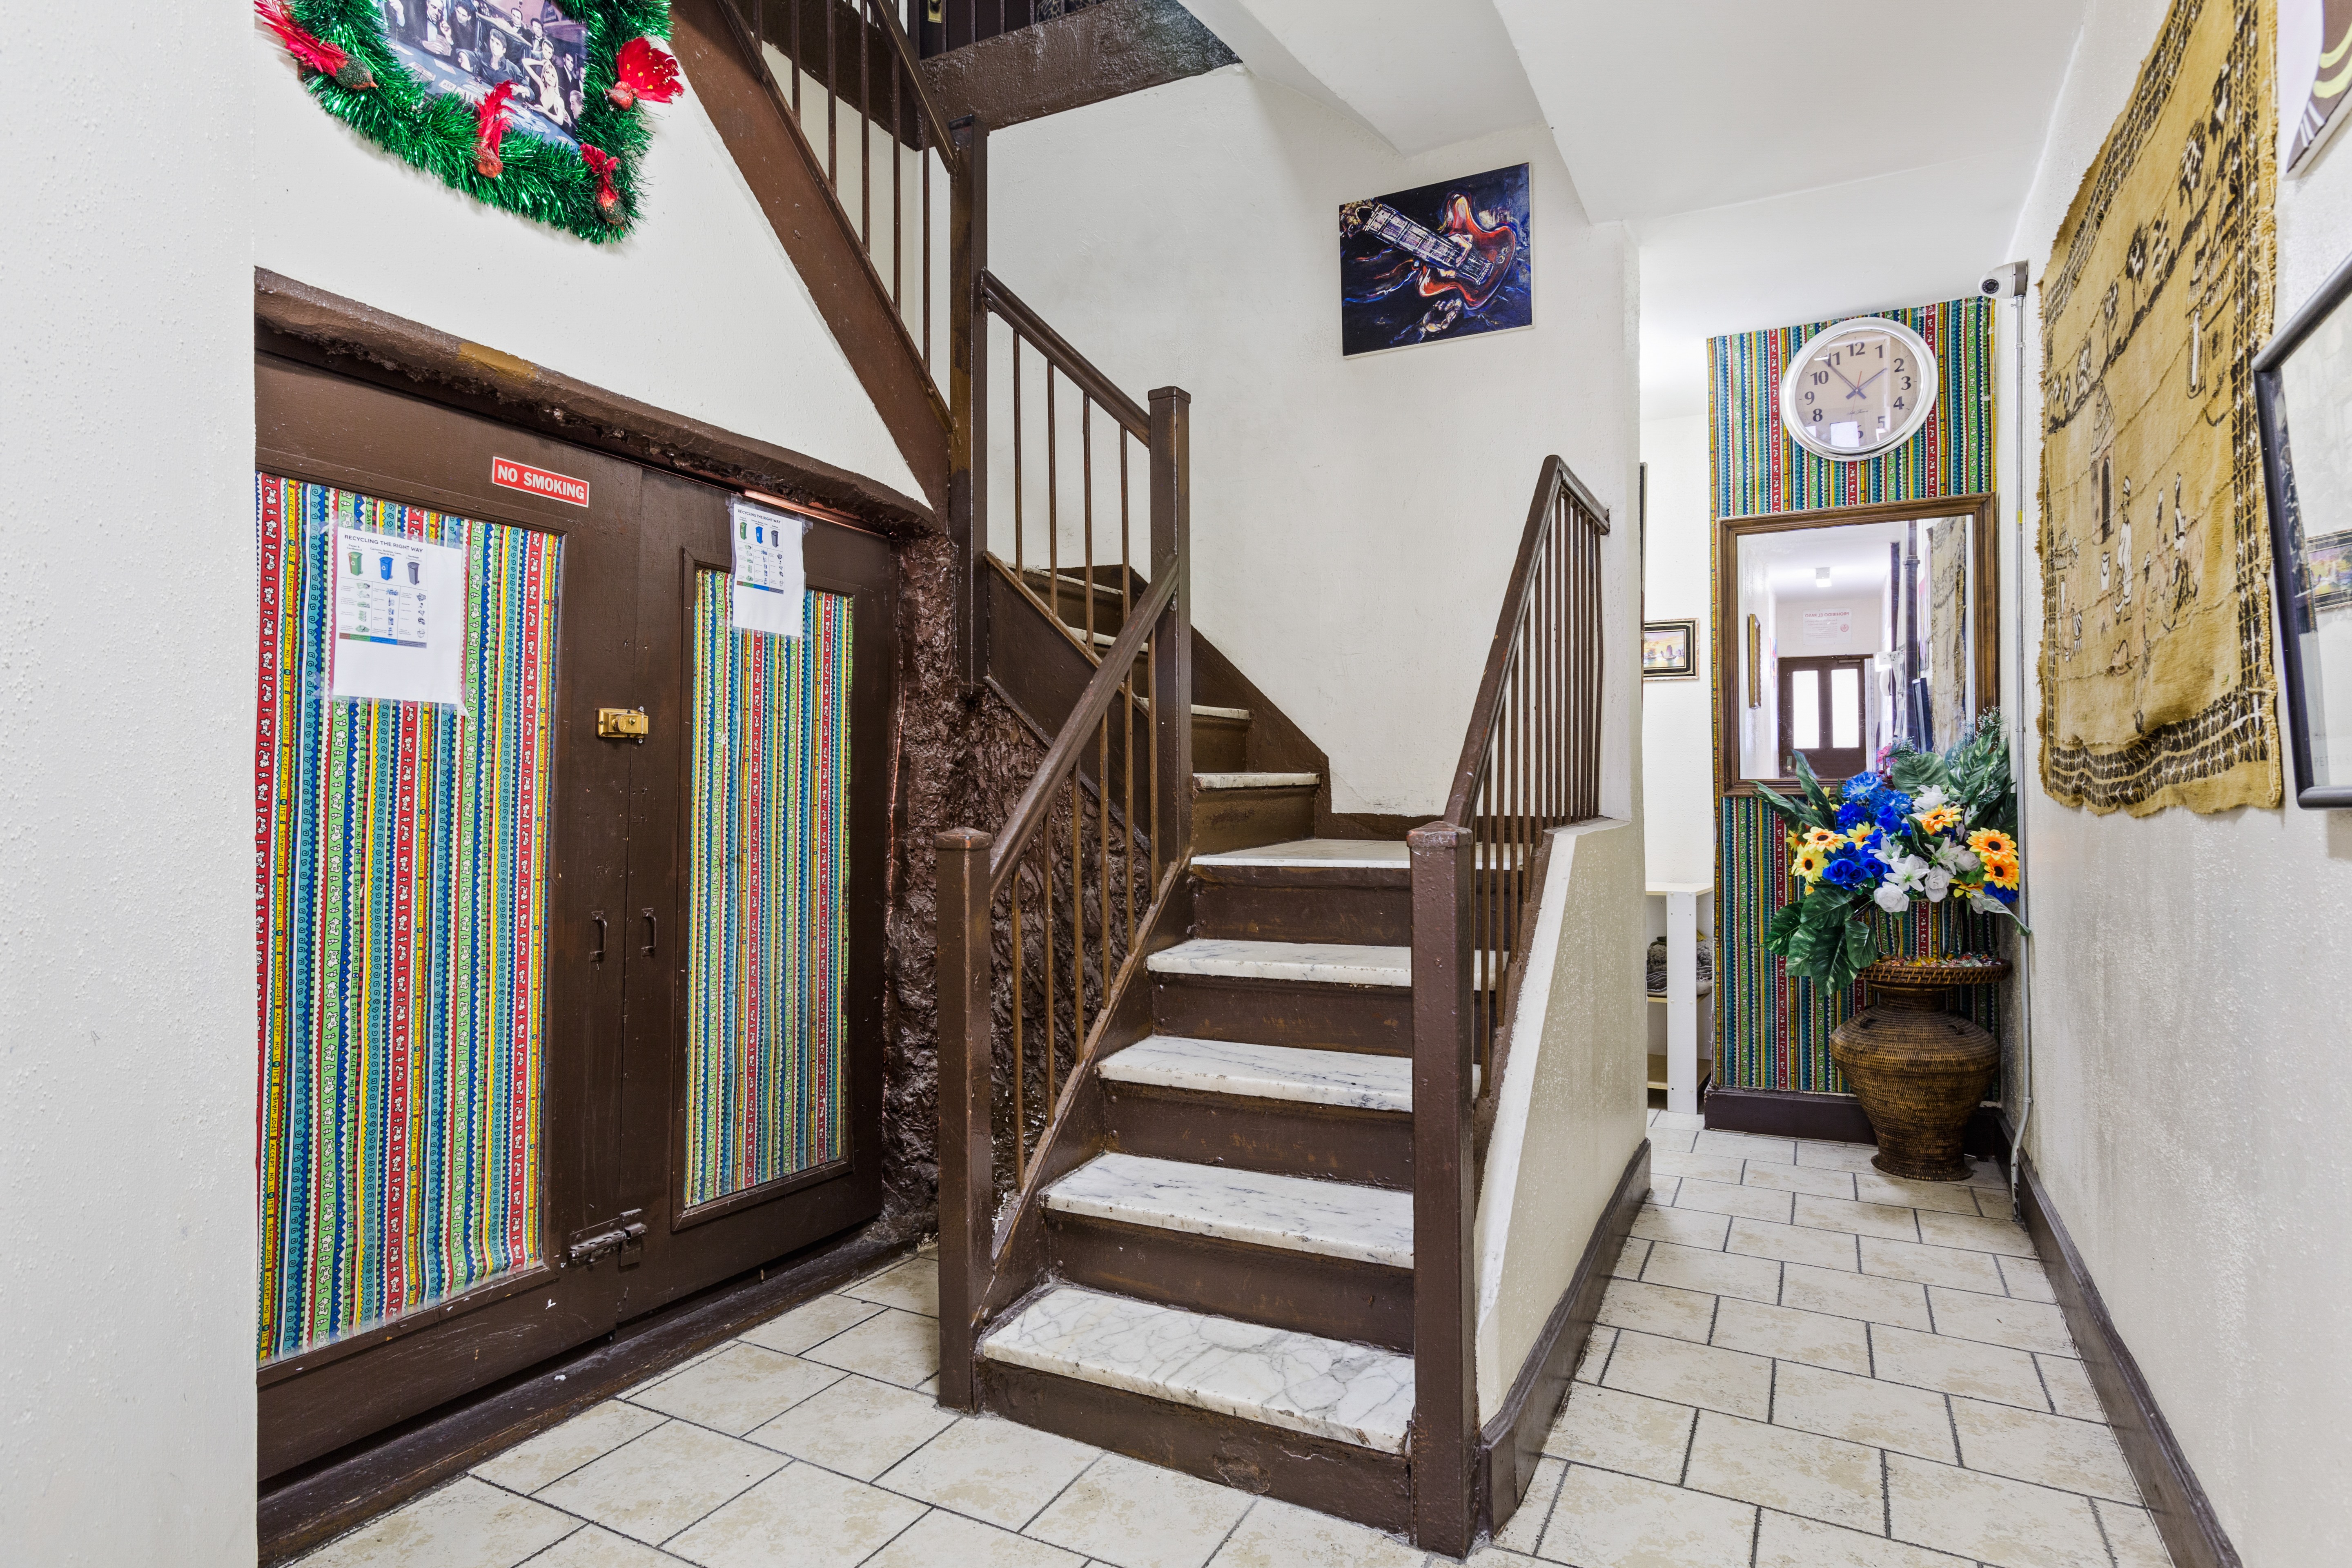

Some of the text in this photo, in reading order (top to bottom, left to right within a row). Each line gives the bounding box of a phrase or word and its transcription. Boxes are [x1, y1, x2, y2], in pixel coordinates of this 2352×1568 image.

[1846, 342, 1865, 356] 12
[1875, 345, 1883, 358] 1
[1824, 352, 1840, 367] 11
[1894, 358, 1904, 373] 2
[1810, 371, 1829, 385] 10
[1901, 376, 1911, 390] 3
[1804, 391, 1815, 405] 9
[1893, 396, 1905, 410] 4
[1813, 409, 1823, 422] 8
[1878, 416, 1885, 429] 5
[498, 465, 584, 500] NO SMOKING
[289, 520, 293, 528] NO
[345, 535, 379, 544] RECYCLING
[281, 780, 286, 788] NO
[277, 910, 282, 918] NO
[274, 1041, 279, 1049] NO
[350, 1079, 354, 1087] NO
[269, 1173, 274, 1181] NO
[264, 1304, 269, 1312] NO
